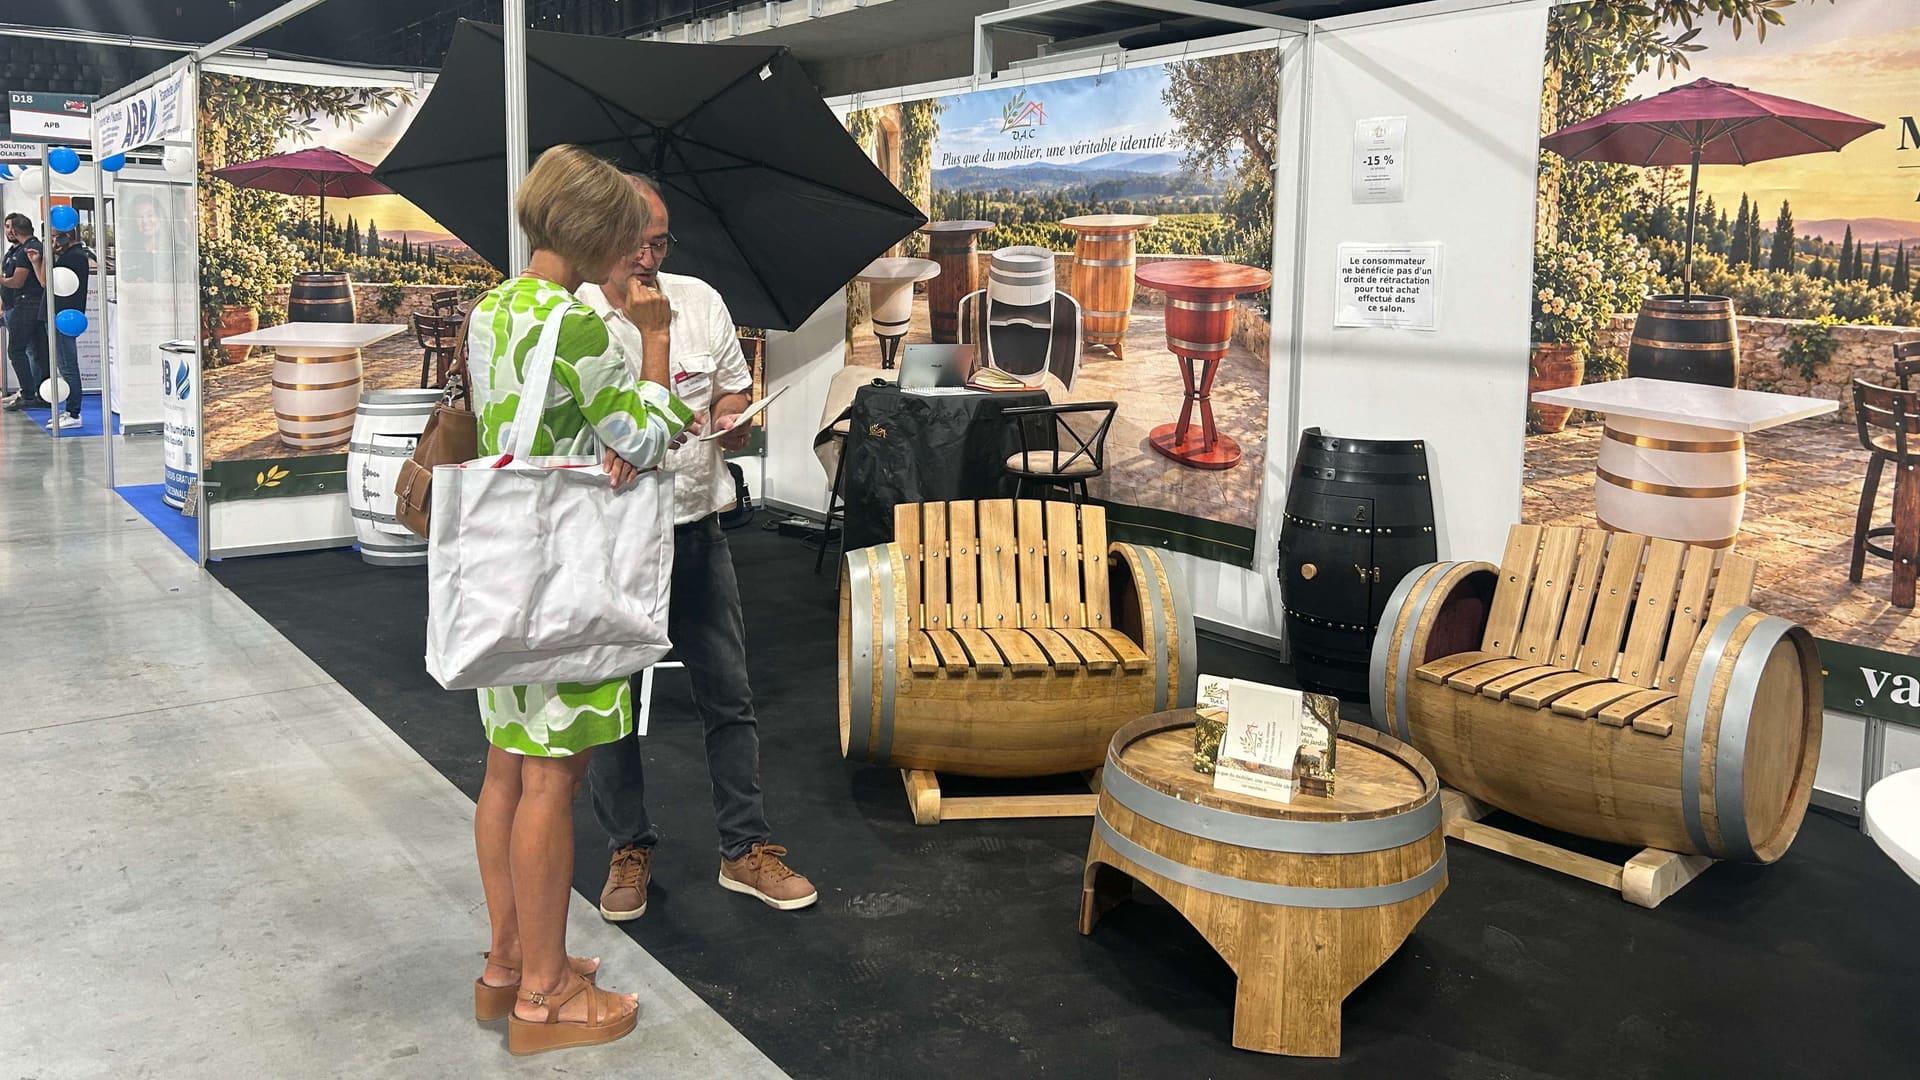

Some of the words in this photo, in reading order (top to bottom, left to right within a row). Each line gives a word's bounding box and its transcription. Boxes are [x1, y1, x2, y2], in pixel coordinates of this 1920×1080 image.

[12, 94, 33, 104] D18
[121, 99, 147, 149] APB
[942, 152, 961, 166] Plus
[962, 153, 980, 168] que
[982, 148, 995, 163] du
[997, 145, 1043, 161] mobilier,
[1046, 145, 1066, 158] une
[1069, 137, 1117, 156] véritable
[1120, 131, 1167, 151] identité
[1363, 155, 1380, 166] -15
[1383, 155, 1394, 166] %
[1350, 257, 1360, 265] Le
[1362, 257, 1426, 265] consommateur
[1355, 266, 1394, 274] bénéficie
[1396, 267, 1412, 276] pas
[1414, 267, 1432, 275] d'un
[1343, 275, 1364, 284] droit
[1366, 276, 1377, 284] de
[1379, 275, 1430, 285] rétractation
[1354, 286, 1374, 294] pour
[1396, 286, 1420, 294] achat
[1357, 294, 1393, 303] effectué
[1394, 295, 1416, 303] dans
[1379, 304, 1405, 313] salon.
[1859, 666, 1920, 707] va
